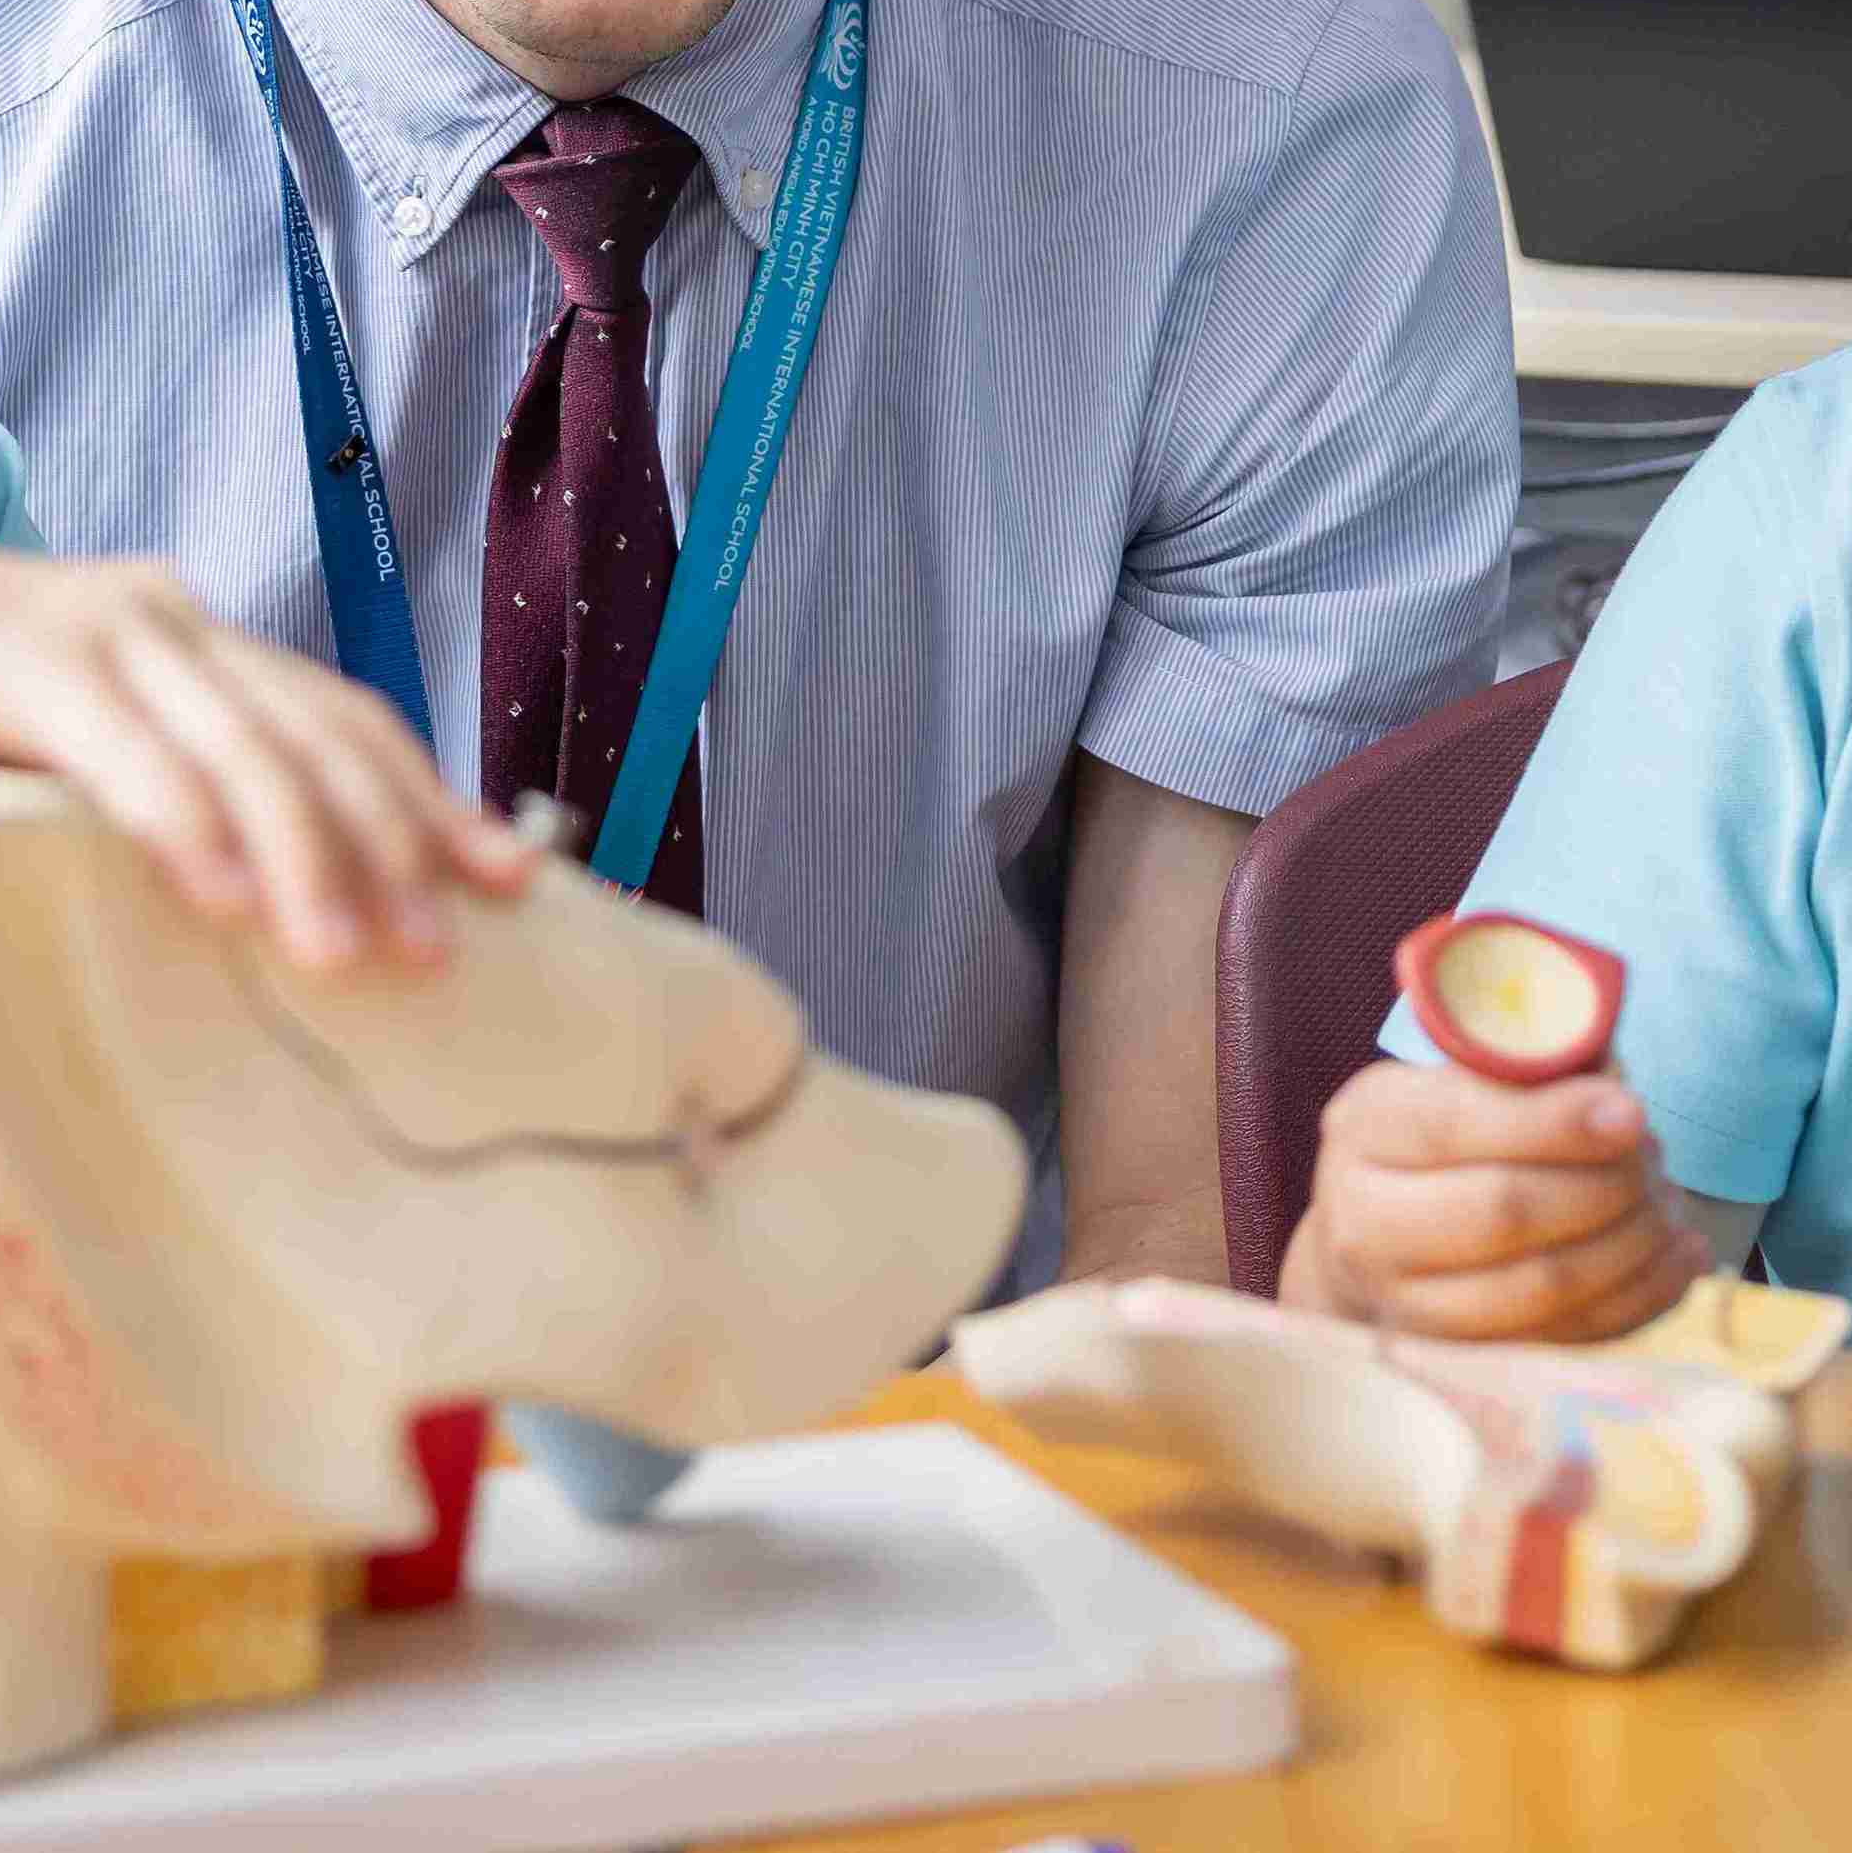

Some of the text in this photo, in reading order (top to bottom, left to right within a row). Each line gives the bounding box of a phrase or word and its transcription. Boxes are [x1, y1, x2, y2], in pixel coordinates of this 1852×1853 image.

[299, 232, 315, 279] CITY
[739, 95, 818, 352] A NORD ANGLIA EDUCATION SCHOOL
[781, 99, 839, 290] HO CHI MINH CITY
[297, 294, 312, 355] SCHOOL
[714, 106, 856, 592] BRITISH VIETNAMESE INTERNATIONAL SCHOOL
[364, 489, 396, 582] SCHOOL
